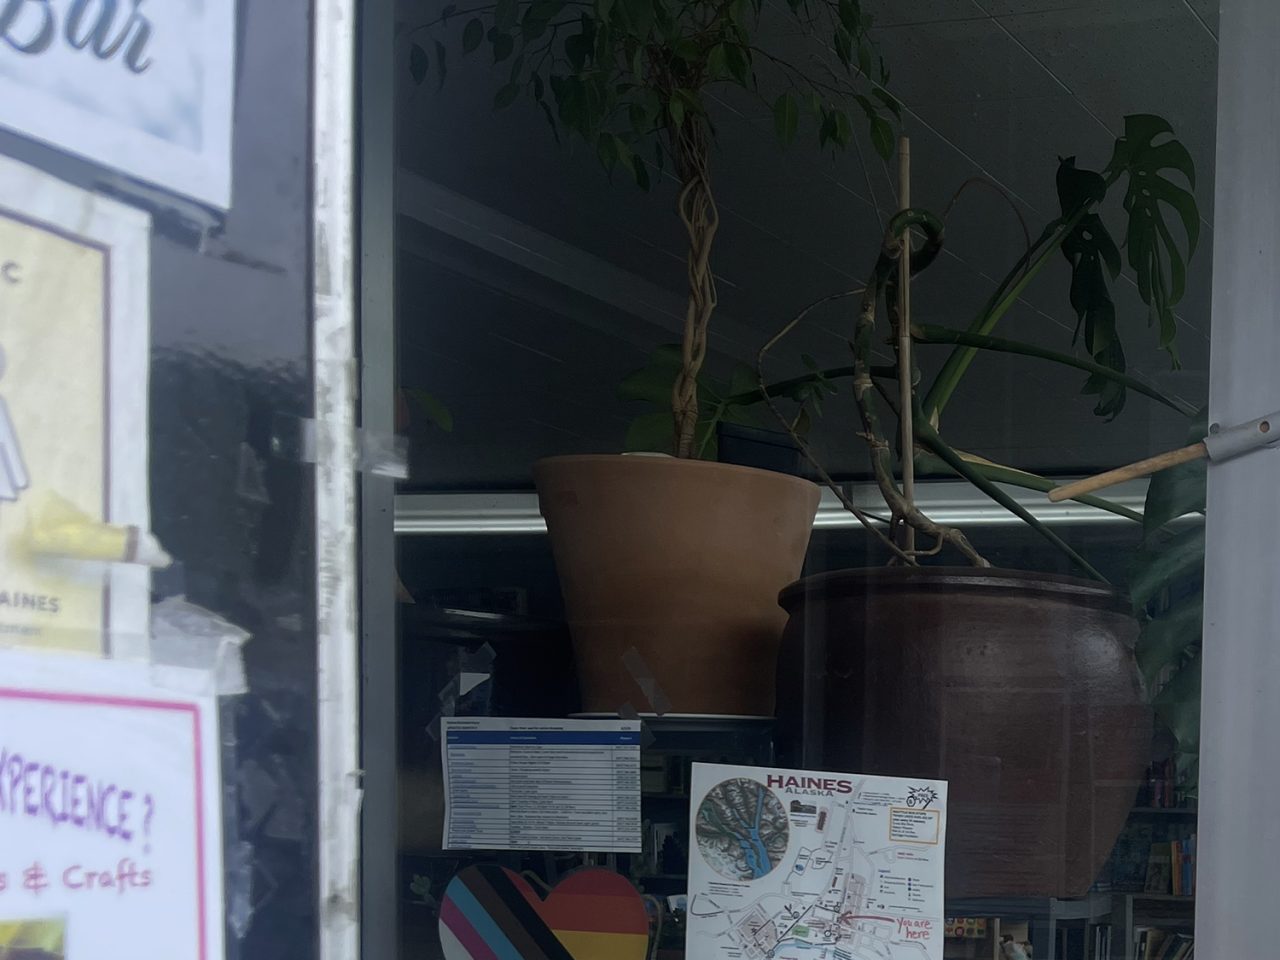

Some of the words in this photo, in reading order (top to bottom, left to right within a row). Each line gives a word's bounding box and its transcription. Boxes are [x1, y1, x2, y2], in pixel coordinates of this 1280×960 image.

[767, 774, 853, 794] HAINES
[785, 787, 834, 797] ALASKA
[22, 862, 47, 892] &
[62, 857, 153, 893] Crafts
[914, 920, 933, 929] are
[906, 926, 930, 940] here
